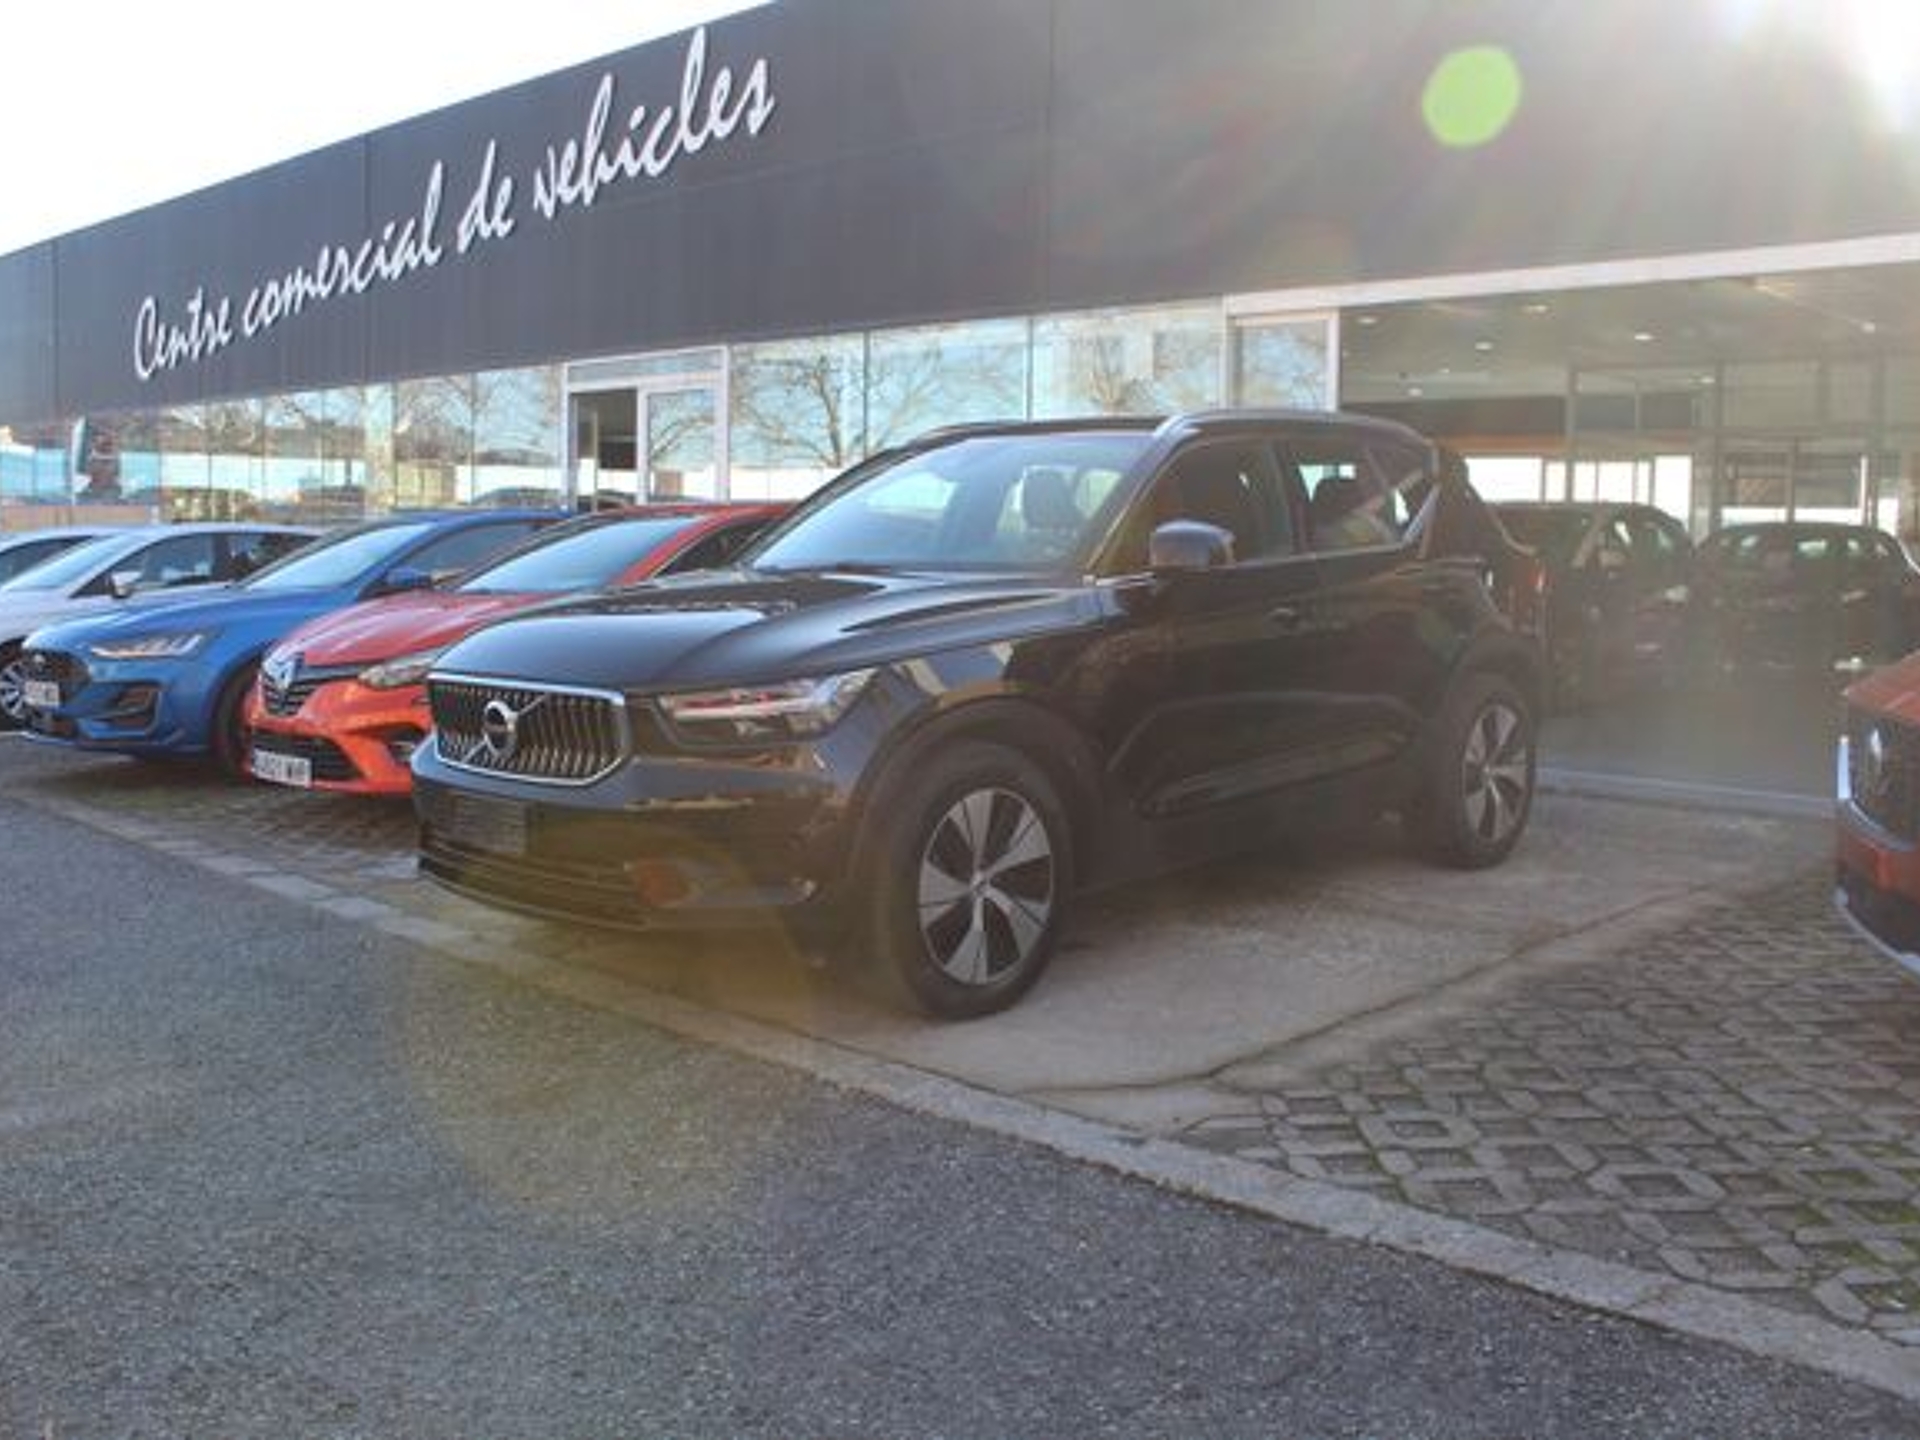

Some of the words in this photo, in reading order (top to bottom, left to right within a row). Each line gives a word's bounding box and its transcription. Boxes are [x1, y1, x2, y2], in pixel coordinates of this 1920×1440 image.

[133, 286, 233, 380] Centre
[241, 160, 443, 337] comercial
[456, 138, 515, 254] de
[532, 25, 776, 219] vehicles
